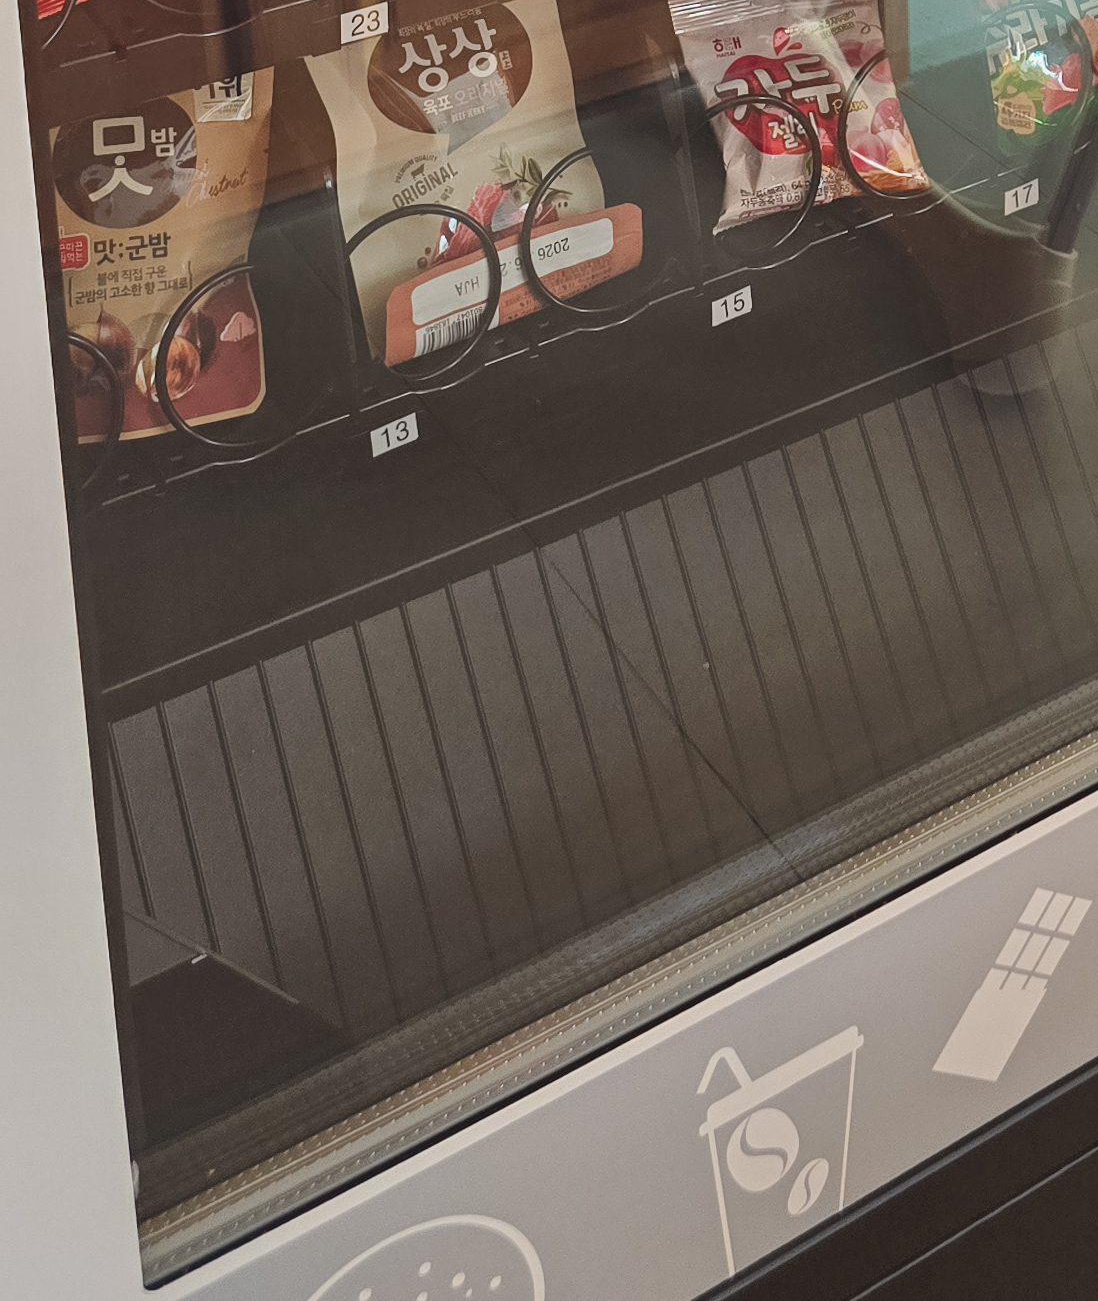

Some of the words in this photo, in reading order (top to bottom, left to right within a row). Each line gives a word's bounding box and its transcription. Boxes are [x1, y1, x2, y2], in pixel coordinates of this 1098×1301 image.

[351, 9, 381, 37] 23
[398, 18, 497, 93] 상상
[715, 51, 736, 59] HAITAI
[423, 95, 454, 116] 육포
[454, 76, 509, 107] 오리지널
[715, 54, 841, 122] 자두
[450, 111, 466, 123] BEEF
[394, 158, 415, 184] PREMIUM
[415, 154, 438, 163] QUALITY
[391, 162, 459, 208] ORIGINAL
[1012, 185, 1034, 208] 17
[121, 267, 143, 280] 직접
[145, 265, 167, 278] 구운
[75, 289, 107, 303] 군밤의
[110, 283, 142, 299] 고소한
[158, 277, 188, 291] 그대로
[454, 275, 480, 297] HJA
[720, 292, 746, 316] 15
[379, 422, 410, 448] 13
